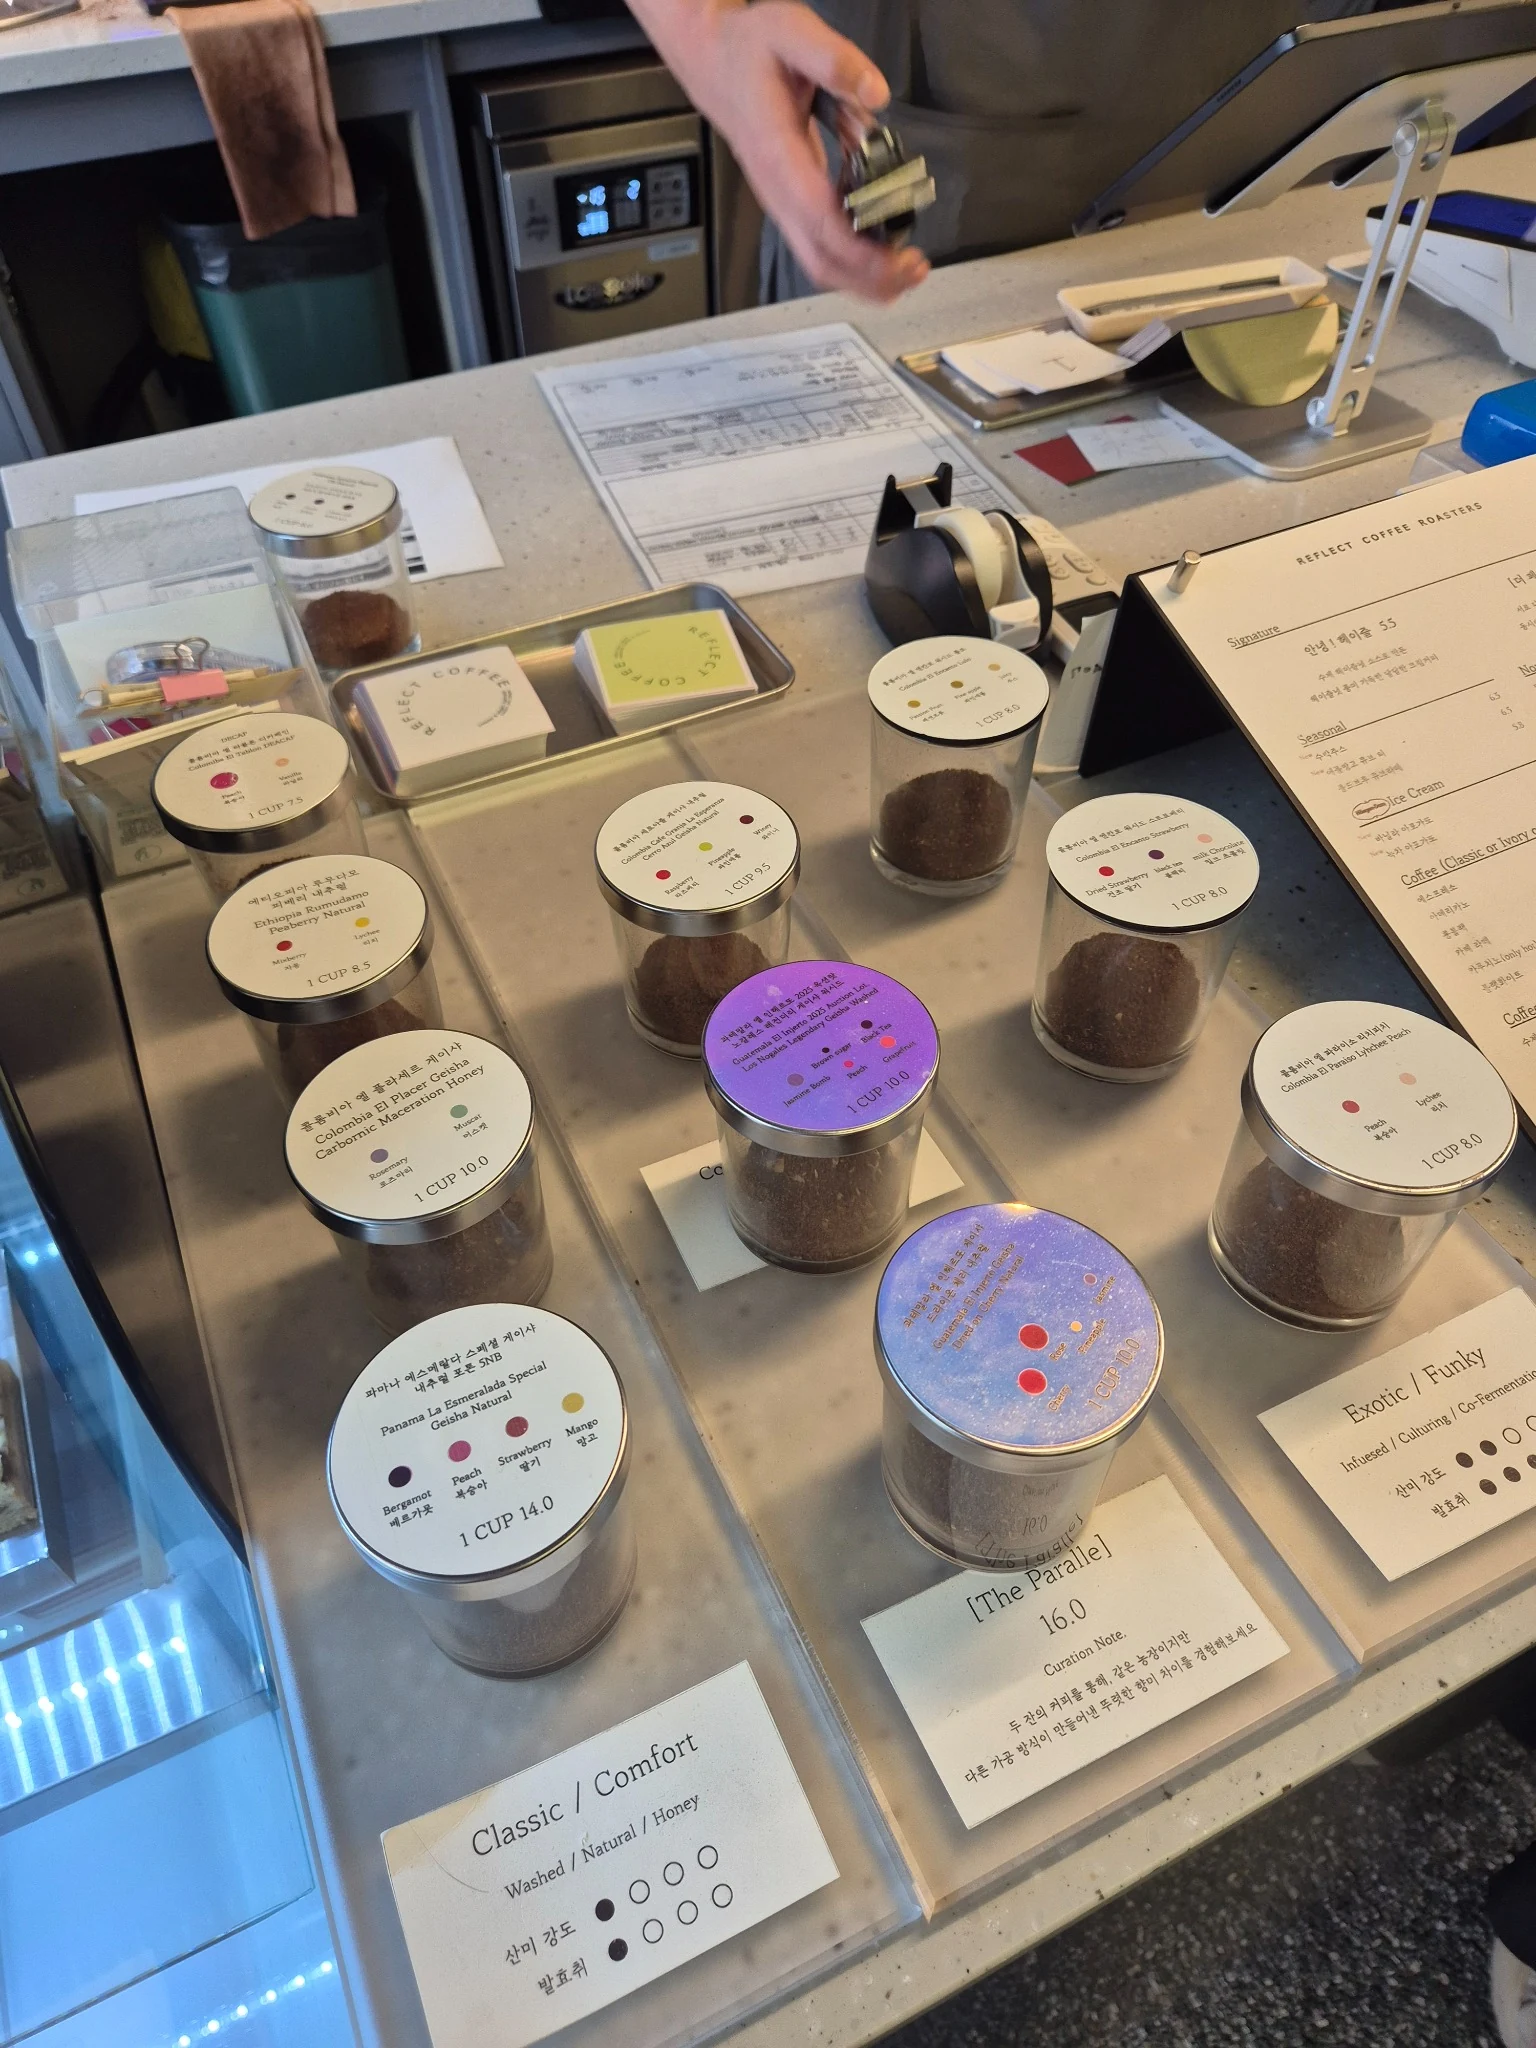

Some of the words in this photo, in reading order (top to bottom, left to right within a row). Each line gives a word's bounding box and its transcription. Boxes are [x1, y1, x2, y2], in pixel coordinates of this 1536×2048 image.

[1296, 541, 1353, 566] REFLECT
[1362, 524, 1412, 545] COFFEE
[1418, 502, 1484, 527] ROASTERS
[687, 625, 722, 679] REFLECT
[1227, 624, 1280, 648] Signature
[1304, 638, 1328, 657] 안녕
[1337, 626, 1373, 646] 헤이즐
[612, 660, 687, 688] COFFEE
[899, 678, 927, 692] Colombia
[396, 680, 437, 738] REFLECT
[432, 665, 511, 689] COFFEE
[983, 711, 1003, 724] CUP
[1004, 704, 1021, 715] 8.0
[1298, 721, 1347, 745] Seasonal
[258, 803, 284, 816] CUP
[287, 796, 304, 807] 7.5
[1387, 795, 1407, 806] Ice
[1407, 781, 1445, 798] Cream
[621, 845, 652, 865] Colombia
[651, 834, 666, 846] Cafe
[688, 816, 696, 824] La
[694, 797, 725, 819] Esperanza
[642, 848, 662, 862] Cerro
[662, 837, 676, 850] Azul
[675, 824, 698, 841] Geisha
[697, 810, 720, 828] Natural
[1076, 848, 1111, 864] Colombia
[1110, 843, 1120, 852] El
[1150, 822, 1190, 839] Strawberry
[708, 847, 736, 867] Pineapple
[1192, 852, 1209, 862] milk
[1209, 840, 1245, 856] Chocolate
[1439, 849, 1485, 872] (Classic
[1486, 842, 1499, 853] or
[1497, 831, 1530, 849] Ivory
[248, 884, 308, 906] 에티오피아
[313, 869, 360, 888] 루무다모
[664, 875, 694, 896] Raspberry
[733, 872, 755, 891] CUP
[755, 862, 771, 877] 9.5
[1085, 884, 1108, 897] Dried
[1108, 871, 1150, 890] Strawberry
[1401, 863, 1440, 886] Coffee
[253, 912, 302, 930] Ethiopia
[305, 891, 370, 914] Rumudamo
[1181, 894, 1206, 908] CUP
[1208, 886, 1228, 899] 8.0
[269, 916, 320, 936] Peaberry
[323, 901, 366, 919] Natural
[353, 928, 381, 941] Lychee
[272, 951, 307, 966] Mixberry
[318, 968, 348, 985] CUP
[352, 961, 371, 974] 8.5
[741, 1061, 758, 1073] Los
[788, 1021, 826, 1047] Legendary
[824, 1004, 851, 1024] Geisha
[849, 987, 880, 1008] Washed
[860, 1029, 881, 1045] Black
[732, 1039, 773, 1066] Guatemala
[773, 1032, 783, 1042] El
[811, 1053, 834, 1069] Brown
[1280, 1072, 1319, 1094] Colombia
[1317, 1065, 1329, 1077] El
[1327, 1052, 1358, 1074] Paraiso
[1386, 1027, 1412, 1044] Peach
[810, 1074, 832, 1090] Bomb
[847, 1064, 869, 1080] Peach
[856, 1086, 883, 1108] CUP
[884, 1070, 910, 1091] 10.0
[315, 1109, 374, 1145] Colombia
[374, 1100, 389, 1113] El
[392, 1080, 428, 1105] Placer
[430, 1058, 471, 1083] Geisha
[315, 1123, 378, 1161] Carbornic
[378, 1087, 446, 1127] Maceration
[446, 1064, 486, 1090] Honey
[1415, 1090, 1442, 1108] Lychee
[1363, 1118, 1388, 1134] Peach
[1422, 1158, 1433, 1170] 1
[1431, 1143, 1461, 1165] CUP
[1460, 1132, 1484, 1151] 8.0
[368, 1156, 409, 1181] Rosemary
[425, 1172, 458, 1197] CUP
[460, 1154, 490, 1178] 10.0
[933, 1308, 969, 1350] Guatemala
[963, 1296, 976, 1307] El
[991, 1243, 1016, 1269] Geisha
[973, 1314, 983, 1326] on
[978, 1286, 1004, 1313] Cherry
[999, 1254, 1024, 1284] Natural
[1093, 1274, 1117, 1306] Jasmine
[1050, 1341, 1067, 1362] Rose
[1078, 1317, 1107, 1356] Pineapple
[1095, 1365, 1121, 1401] CUP
[1116, 1338, 1142, 1367] 10.0
[1341, 1384, 1410, 1425] Exotic
[1422, 1347, 1487, 1385] Funky
[380, 1413, 426, 1437] Panama
[427, 1405, 443, 1419] La
[508, 1360, 548, 1386] Special
[430, 1409, 469, 1432] Geisha
[471, 1390, 514, 1417] Natural
[1048, 1384, 1072, 1413] Cherry
[497, 1437, 553, 1468] Strawberry
[1340, 1442, 1391, 1473] Infuesed
[1397, 1413, 1452, 1446] Culturing
[451, 1467, 483, 1487] Peach
[1395, 1478, 1421, 1499] 산미
[1419, 1466, 1447, 1487] 강도
[382, 1489, 433, 1517] Bergamot
[474, 1511, 514, 1542] CUP
[520, 1495, 555, 1521] 14.0
[1430, 1492, 1471, 1519] 발효취
[965, 1584, 1026, 1624] [The
[1024, 1532, 1114, 1593] Paralle]
[1039, 1597, 1088, 1638] 16.0
[1043, 1644, 1095, 1678] Curation
[1022, 1703, 1049, 1728] 잔의
[1048, 1684, 1084, 1713] 커피를
[1111, 1658, 1136, 1679] 같은
[1134, 1629, 1192, 1668] 농장이지만
[963, 1764, 991, 1785] 다른
[989, 1749, 1016, 1772] 가공
[1015, 1729, 1053, 1757] 방식이
[1051, 1704, 1101, 1739] 만들어낸
[470, 1799, 565, 1858] Classic
[592, 1731, 700, 1800] Comfort
[503, 1861, 567, 1900] Washed
[581, 1823, 638, 1865] Natural
[652, 1792, 702, 1827] Honey
[504, 1939, 539, 1968] 산미
[542, 1919, 578, 1949] 강도
[536, 1957, 589, 1998] 발효취
